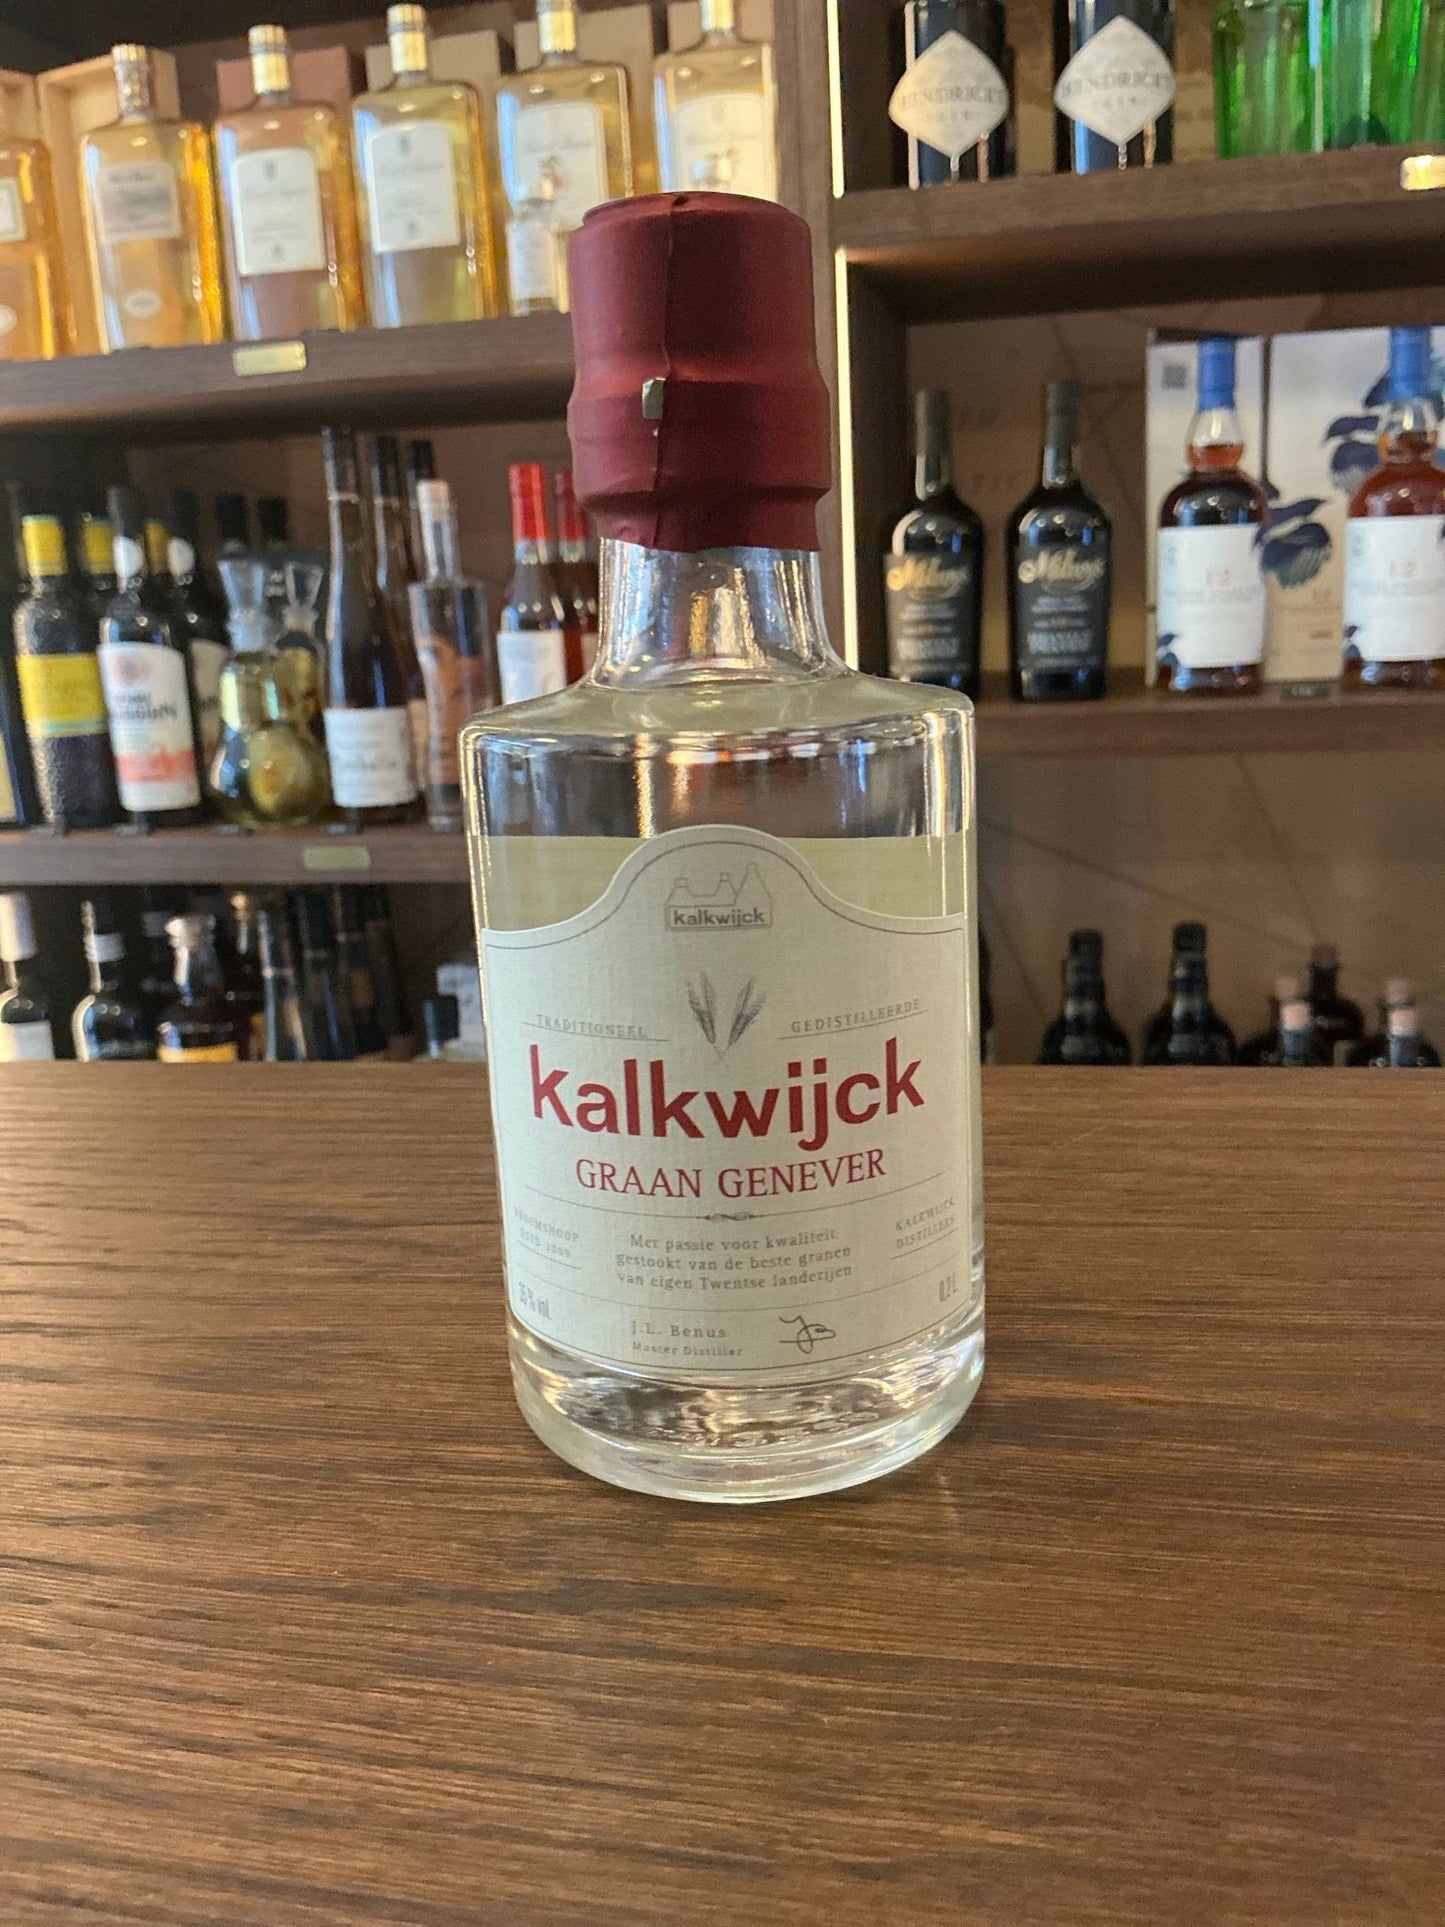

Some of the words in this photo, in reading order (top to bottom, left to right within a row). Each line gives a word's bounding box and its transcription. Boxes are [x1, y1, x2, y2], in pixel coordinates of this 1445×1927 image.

[673, 907, 765, 927] kalkwijck
[536, 1013, 648, 1038] TRADITIONEEL
[790, 998, 921, 1034] GEDISTILLEERDE
[529, 1036, 925, 1152] kalkwijck
[576, 1158, 702, 1198] GRAAN
[717, 1148, 887, 1198] GENEVER
[630, 1233, 658, 1249] Met
[665, 1239, 715, 1253] passie
[721, 1240, 758, 1251] voor
[766, 1229, 837, 1249] kwaliteit
[616, 1253, 681, 1270] gestookt
[688, 1260, 718, 1271] van
[724, 1257, 743, 1271] de
[750, 1256, 792, 1270] beste
[798, 1246, 851, 1268] granen
[617, 1272, 645, 1287] van
[651, 1275, 693, 1292] eigen
[699, 1276, 766, 1291] Twentse
[773, 1265, 852, 1287] landerijen
[670, 1325, 727, 1338] Benus
[632, 1341, 678, 1355] Master
[683, 1345, 744, 1357] Distiller
